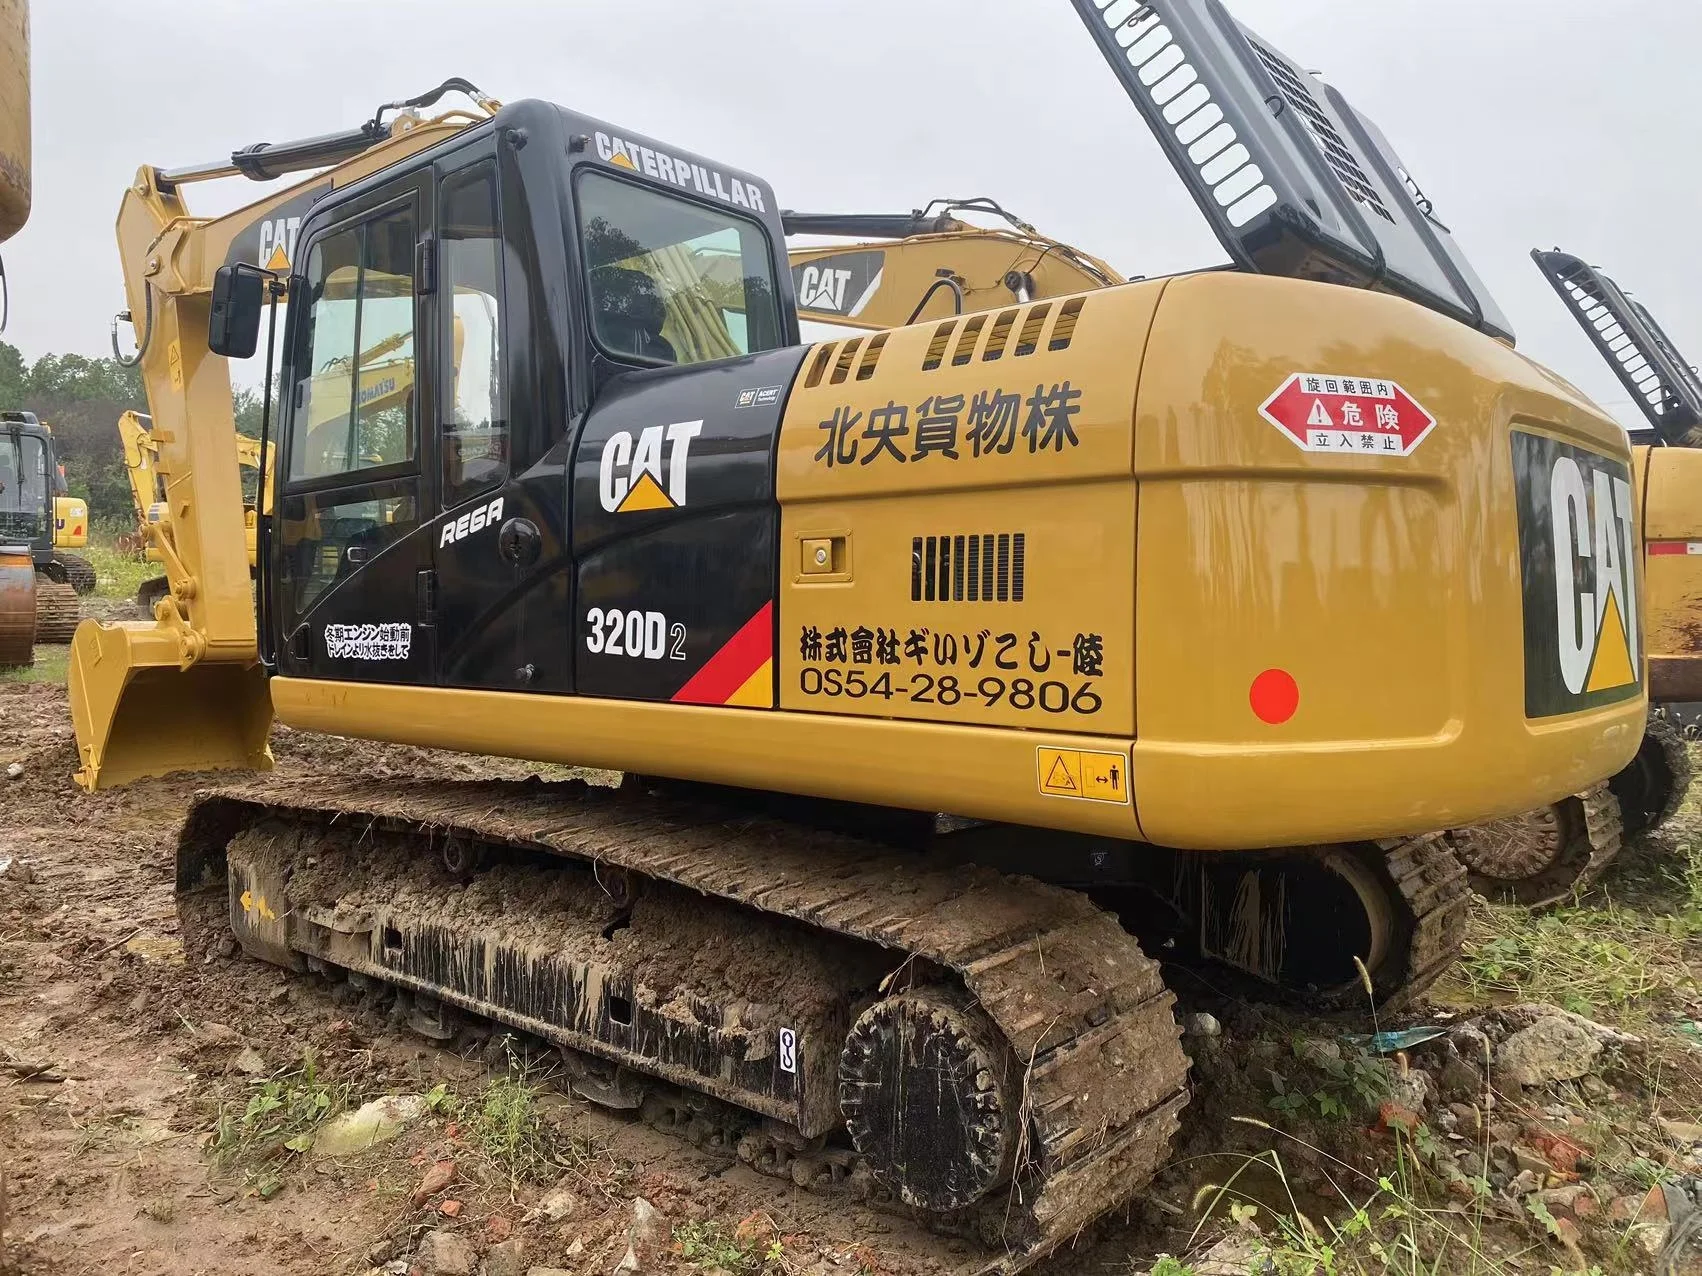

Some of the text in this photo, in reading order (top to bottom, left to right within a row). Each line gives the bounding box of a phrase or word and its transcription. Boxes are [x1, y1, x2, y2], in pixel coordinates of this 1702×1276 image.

[595, 131, 765, 213] CATERPILLAR
[259, 217, 300, 269] CAT
[800, 266, 852, 310] CAT
[739, 391, 756, 402] CAT
[1306, 377, 1389, 396] 旋回範囲内
[814, 380, 1082, 468] 北央貨物株
[1340, 401, 1400, 430] 危険
[1315, 433, 1396, 450] 立入禁止
[600, 420, 703, 513] CAT
[440, 497, 504, 549] REGA
[1550, 456, 1639, 695] CAT
[325, 624, 411, 643] 冬期エンジン始動前
[327, 642, 410, 659] ドレインより水抜きをして
